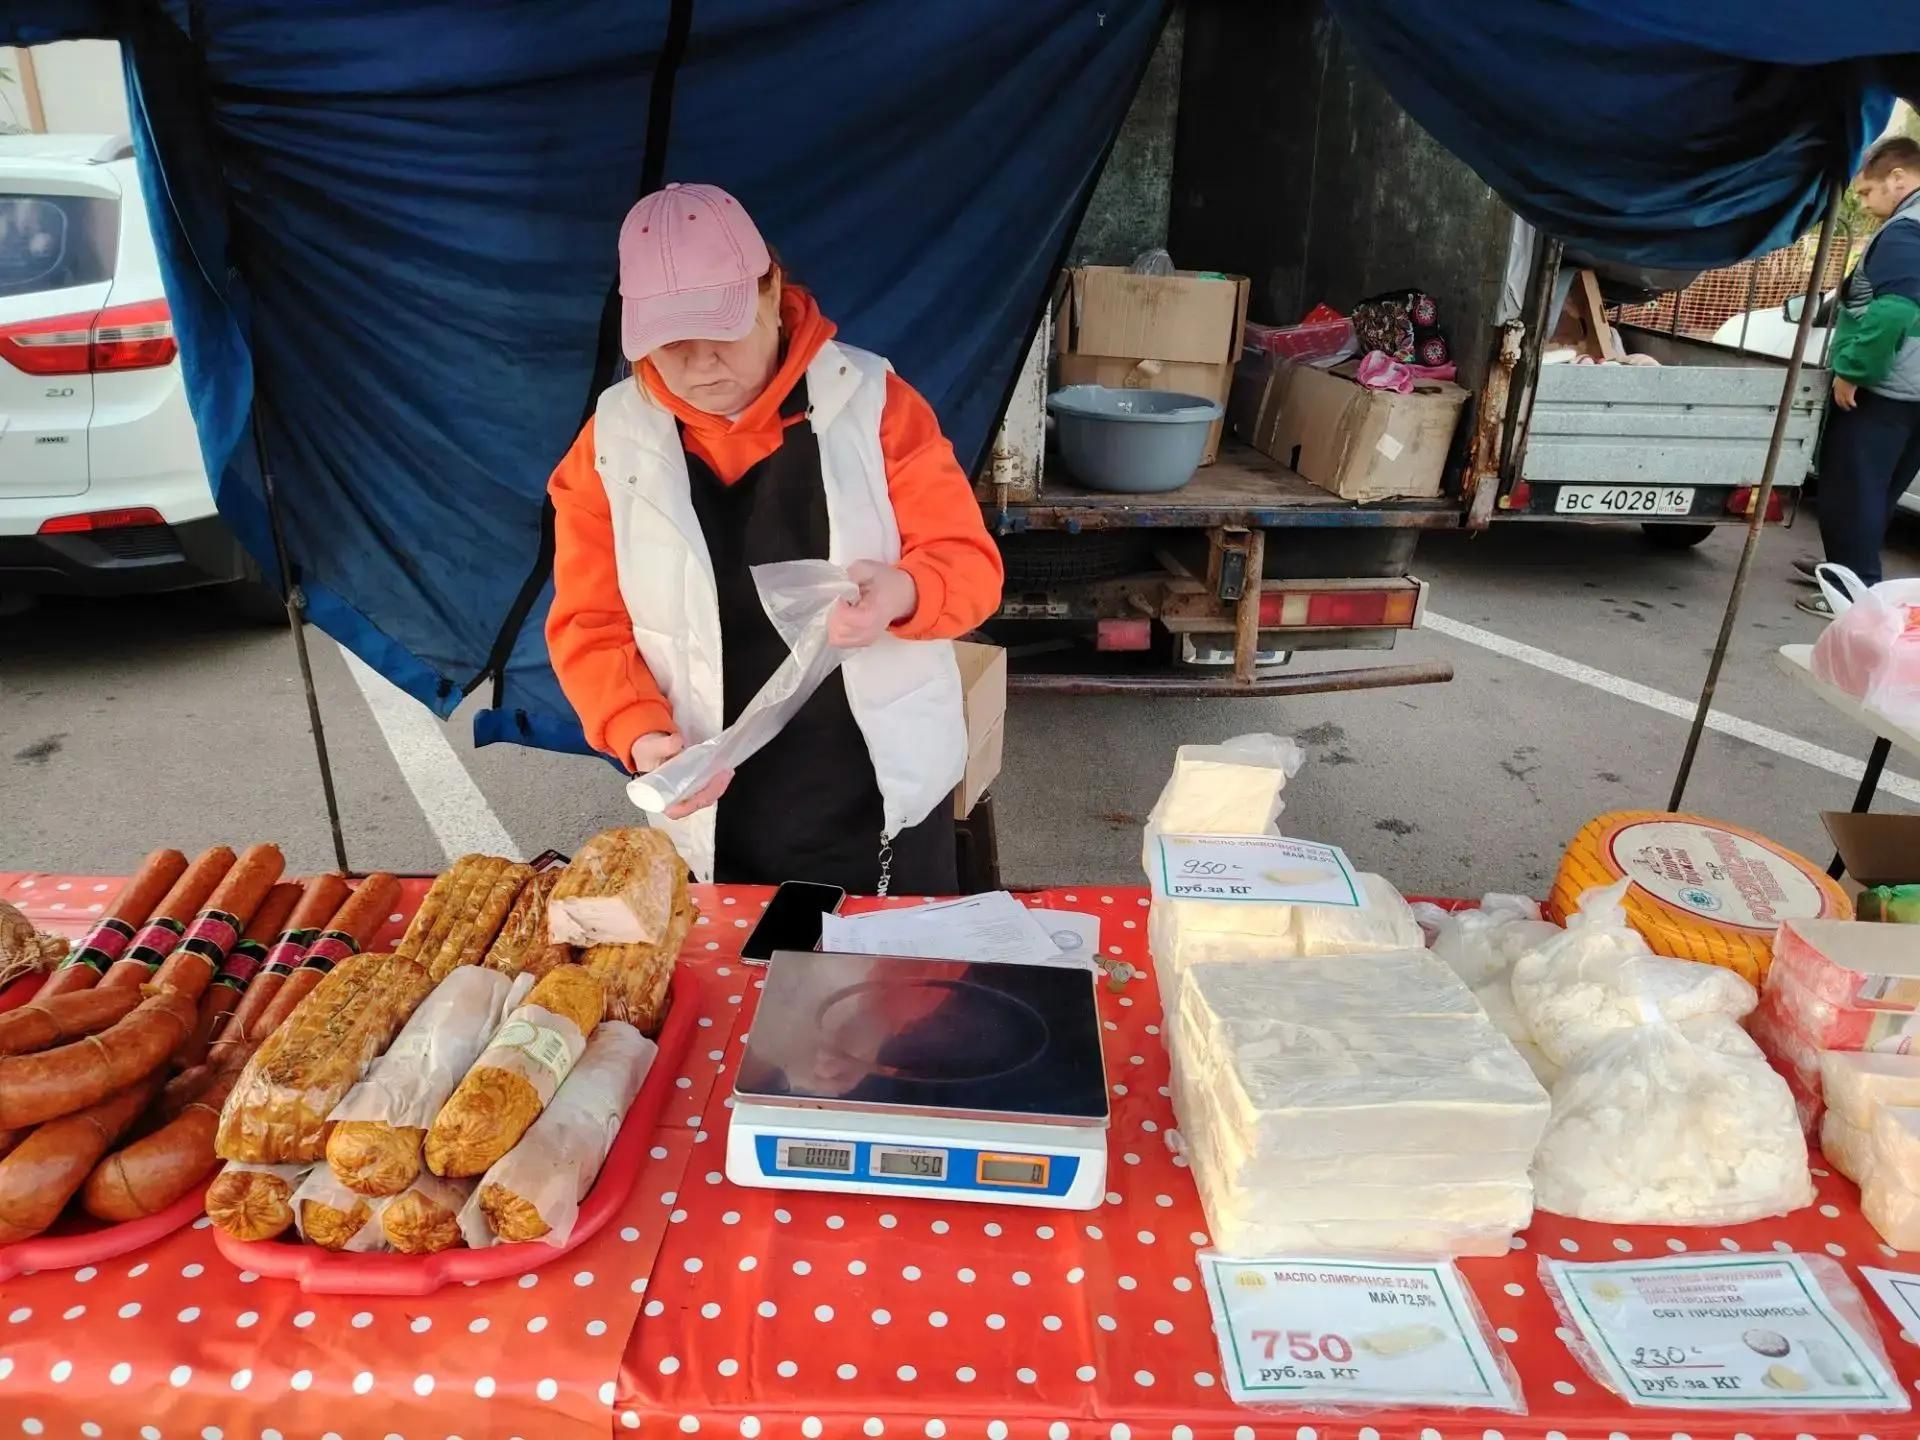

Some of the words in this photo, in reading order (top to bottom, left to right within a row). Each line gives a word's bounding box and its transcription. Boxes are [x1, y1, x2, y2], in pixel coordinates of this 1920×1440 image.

[1600, 489, 1657, 511] 4028
[1664, 490, 1684, 506] 16
[1174, 884, 1224, 894] руб.за
[1230, 886, 1252, 894] КГ
[911, 1155, 942, 1174] 450
[1031, 1163, 1042, 1183] 0
[1274, 1271, 1317, 1283] МАСЛО
[1320, 1273, 1393, 1288] СЛИВОЧНОЕ
[1369, 1289, 1399, 1305] МАЙ
[1400, 1293, 1437, 1308] 72,5%
[1251, 1329, 1353, 1363] 750
[1260, 1365, 1326, 1381] руб.за
[1331, 1368, 1360, 1380] КГ
[1641, 1376, 1710, 1391] руб.за
[1712, 1376, 1742, 1389] КГ
